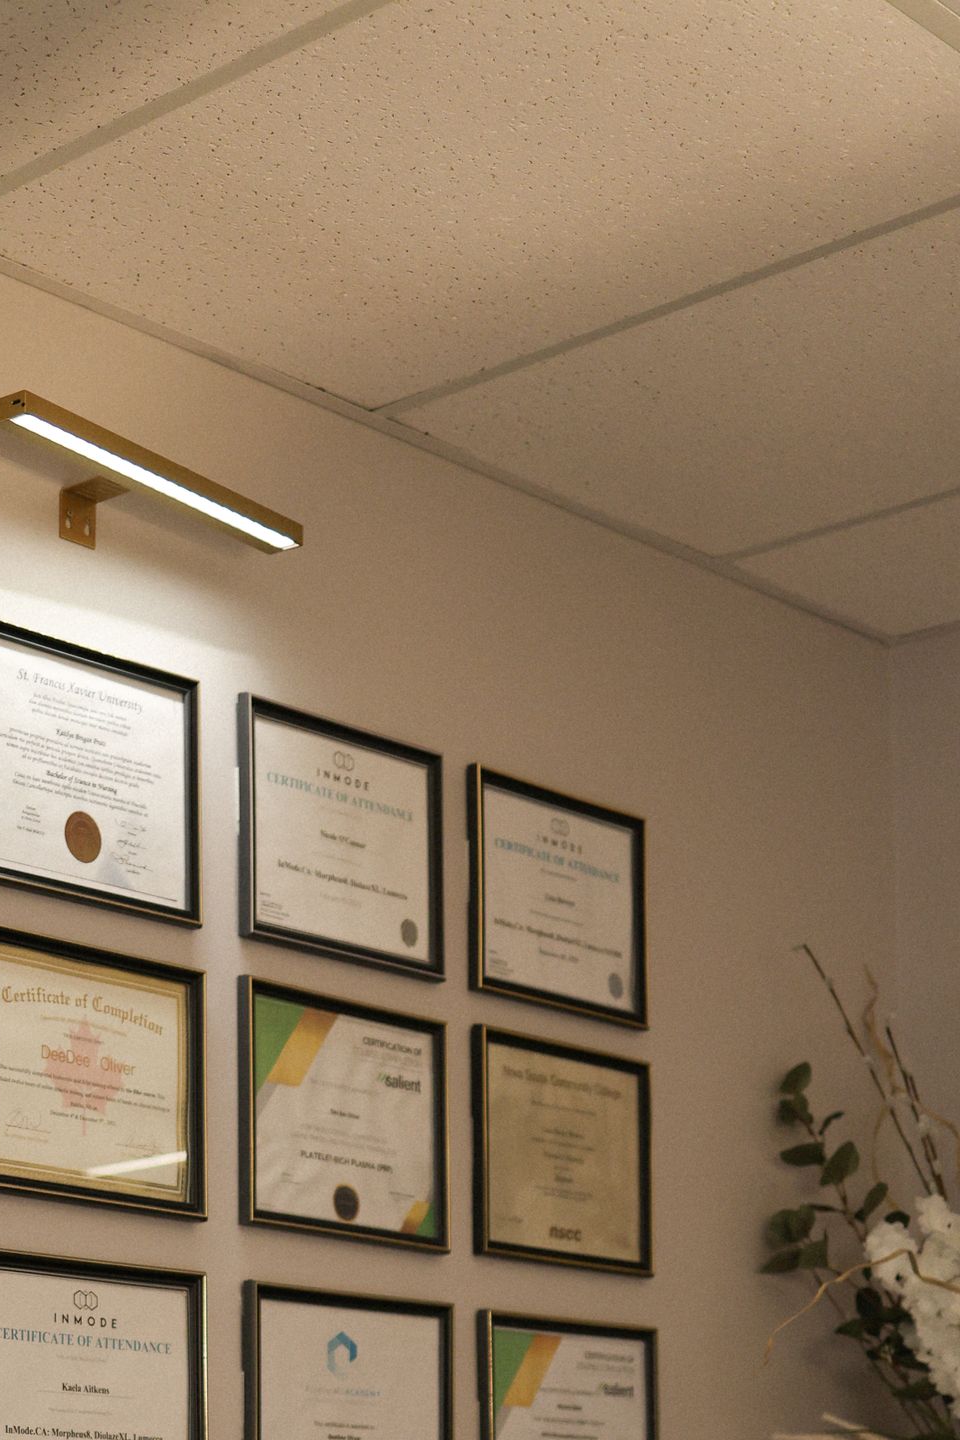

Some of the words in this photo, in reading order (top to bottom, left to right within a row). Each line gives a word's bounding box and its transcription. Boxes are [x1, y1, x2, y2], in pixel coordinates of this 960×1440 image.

[0, 985, 71, 1006] Certificate
[74, 993, 88, 1009] of
[91, 995, 164, 1036] Completion
[53, 1312, 117, 1329] INMODE
[76, 1335, 91, 1348] OF
[97, 1337, 170, 1355] ATTENDANCE
